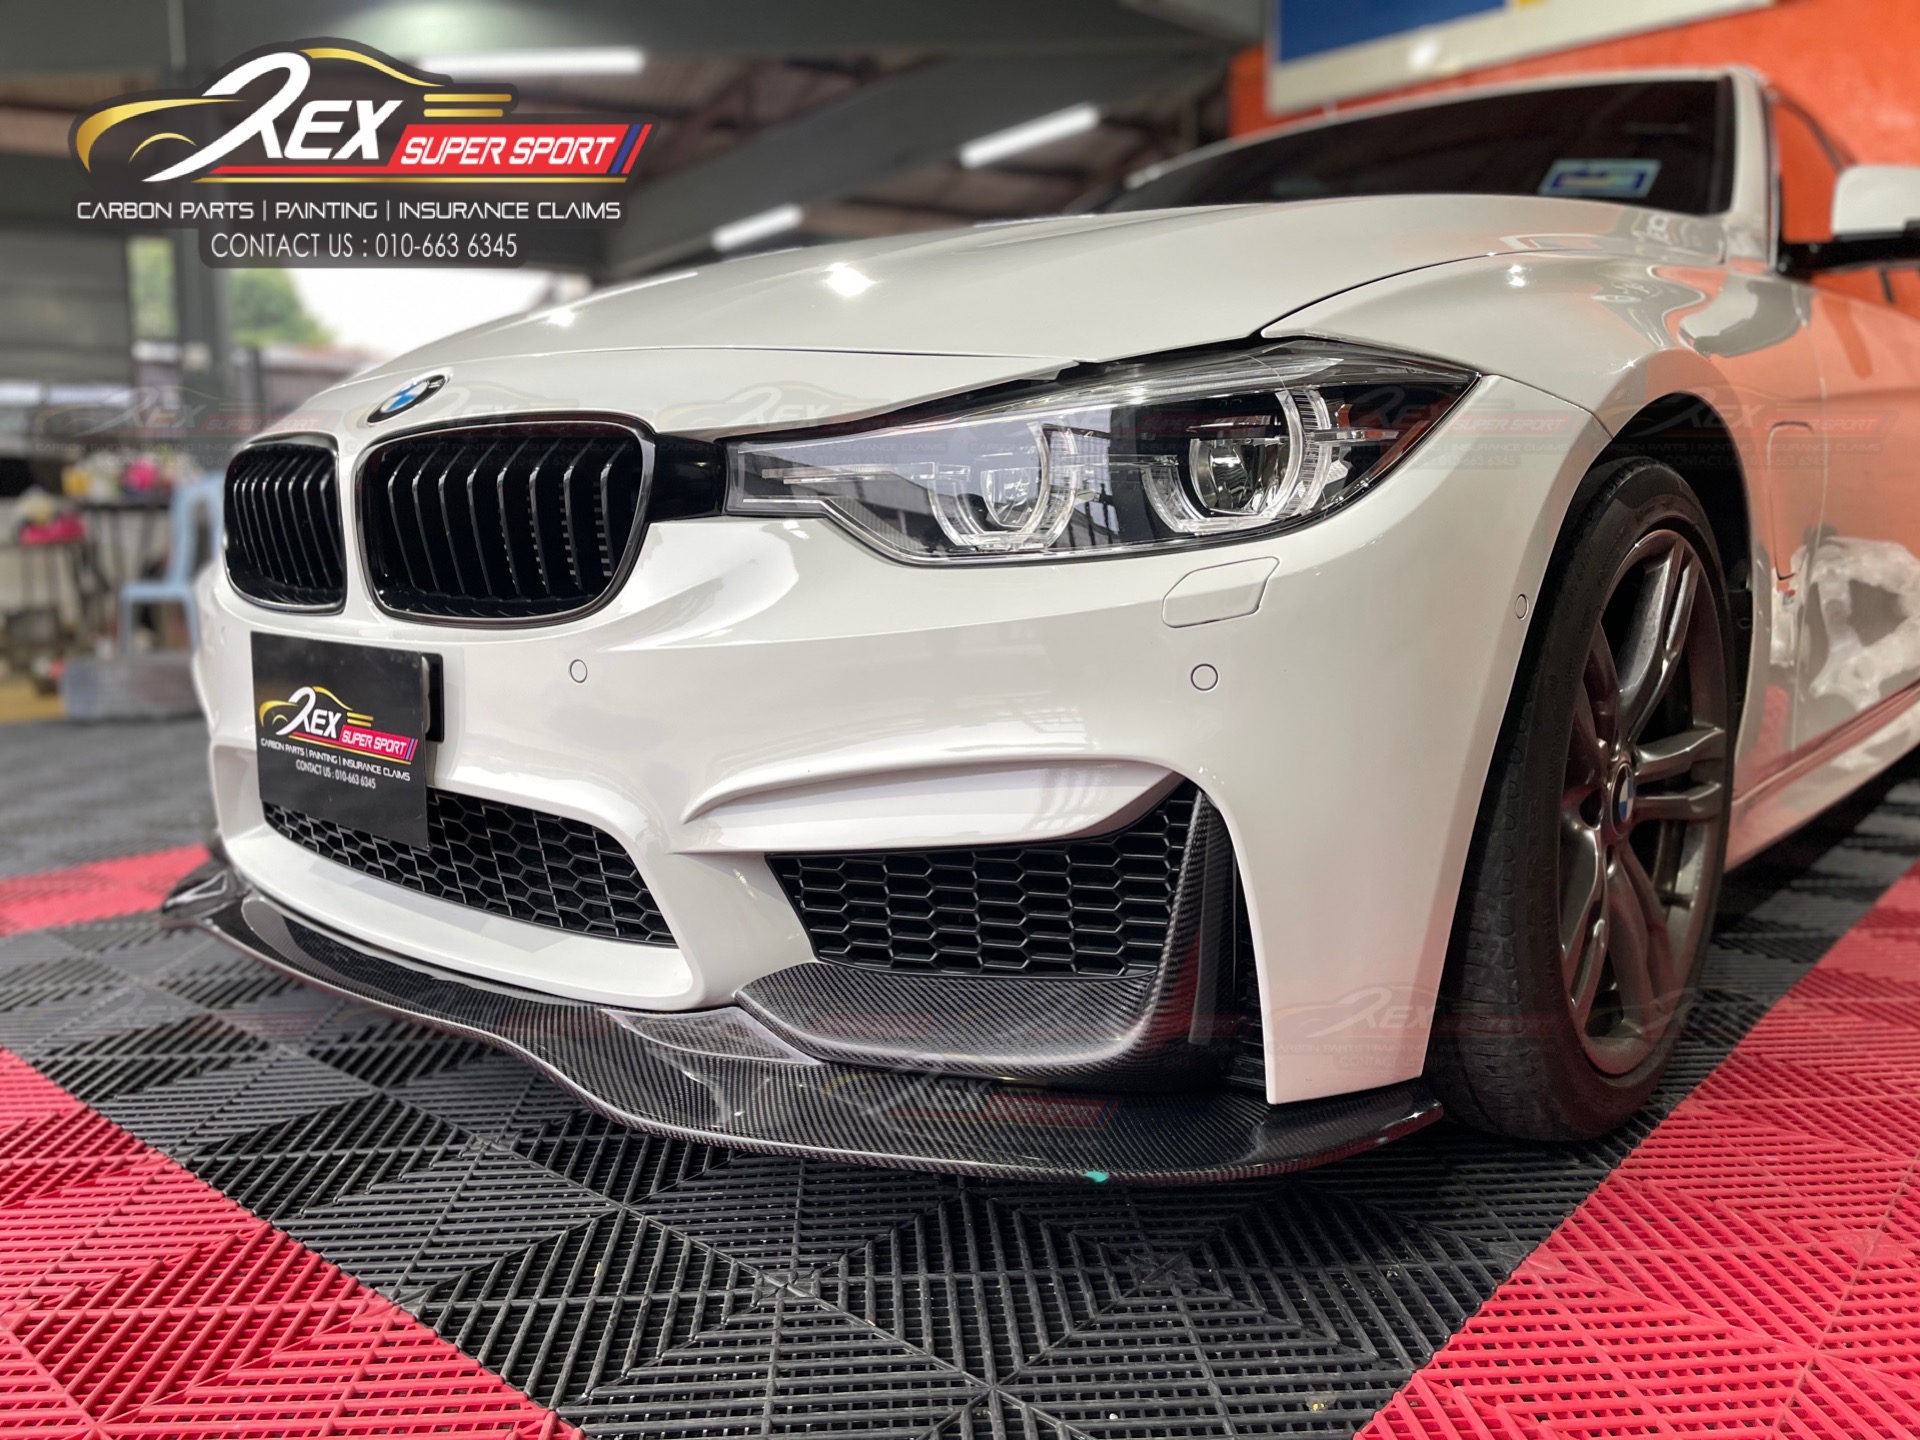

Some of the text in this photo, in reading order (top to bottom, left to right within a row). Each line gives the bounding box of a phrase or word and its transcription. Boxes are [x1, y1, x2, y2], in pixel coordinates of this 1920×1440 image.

[341, 730, 407, 756] SUPER SPORT
[260, 737, 411, 782] CARBON PARTS PAINTING INSURANCE CLAIMS
[295, 758, 377, 790] CONTACT US 010-663 6345
